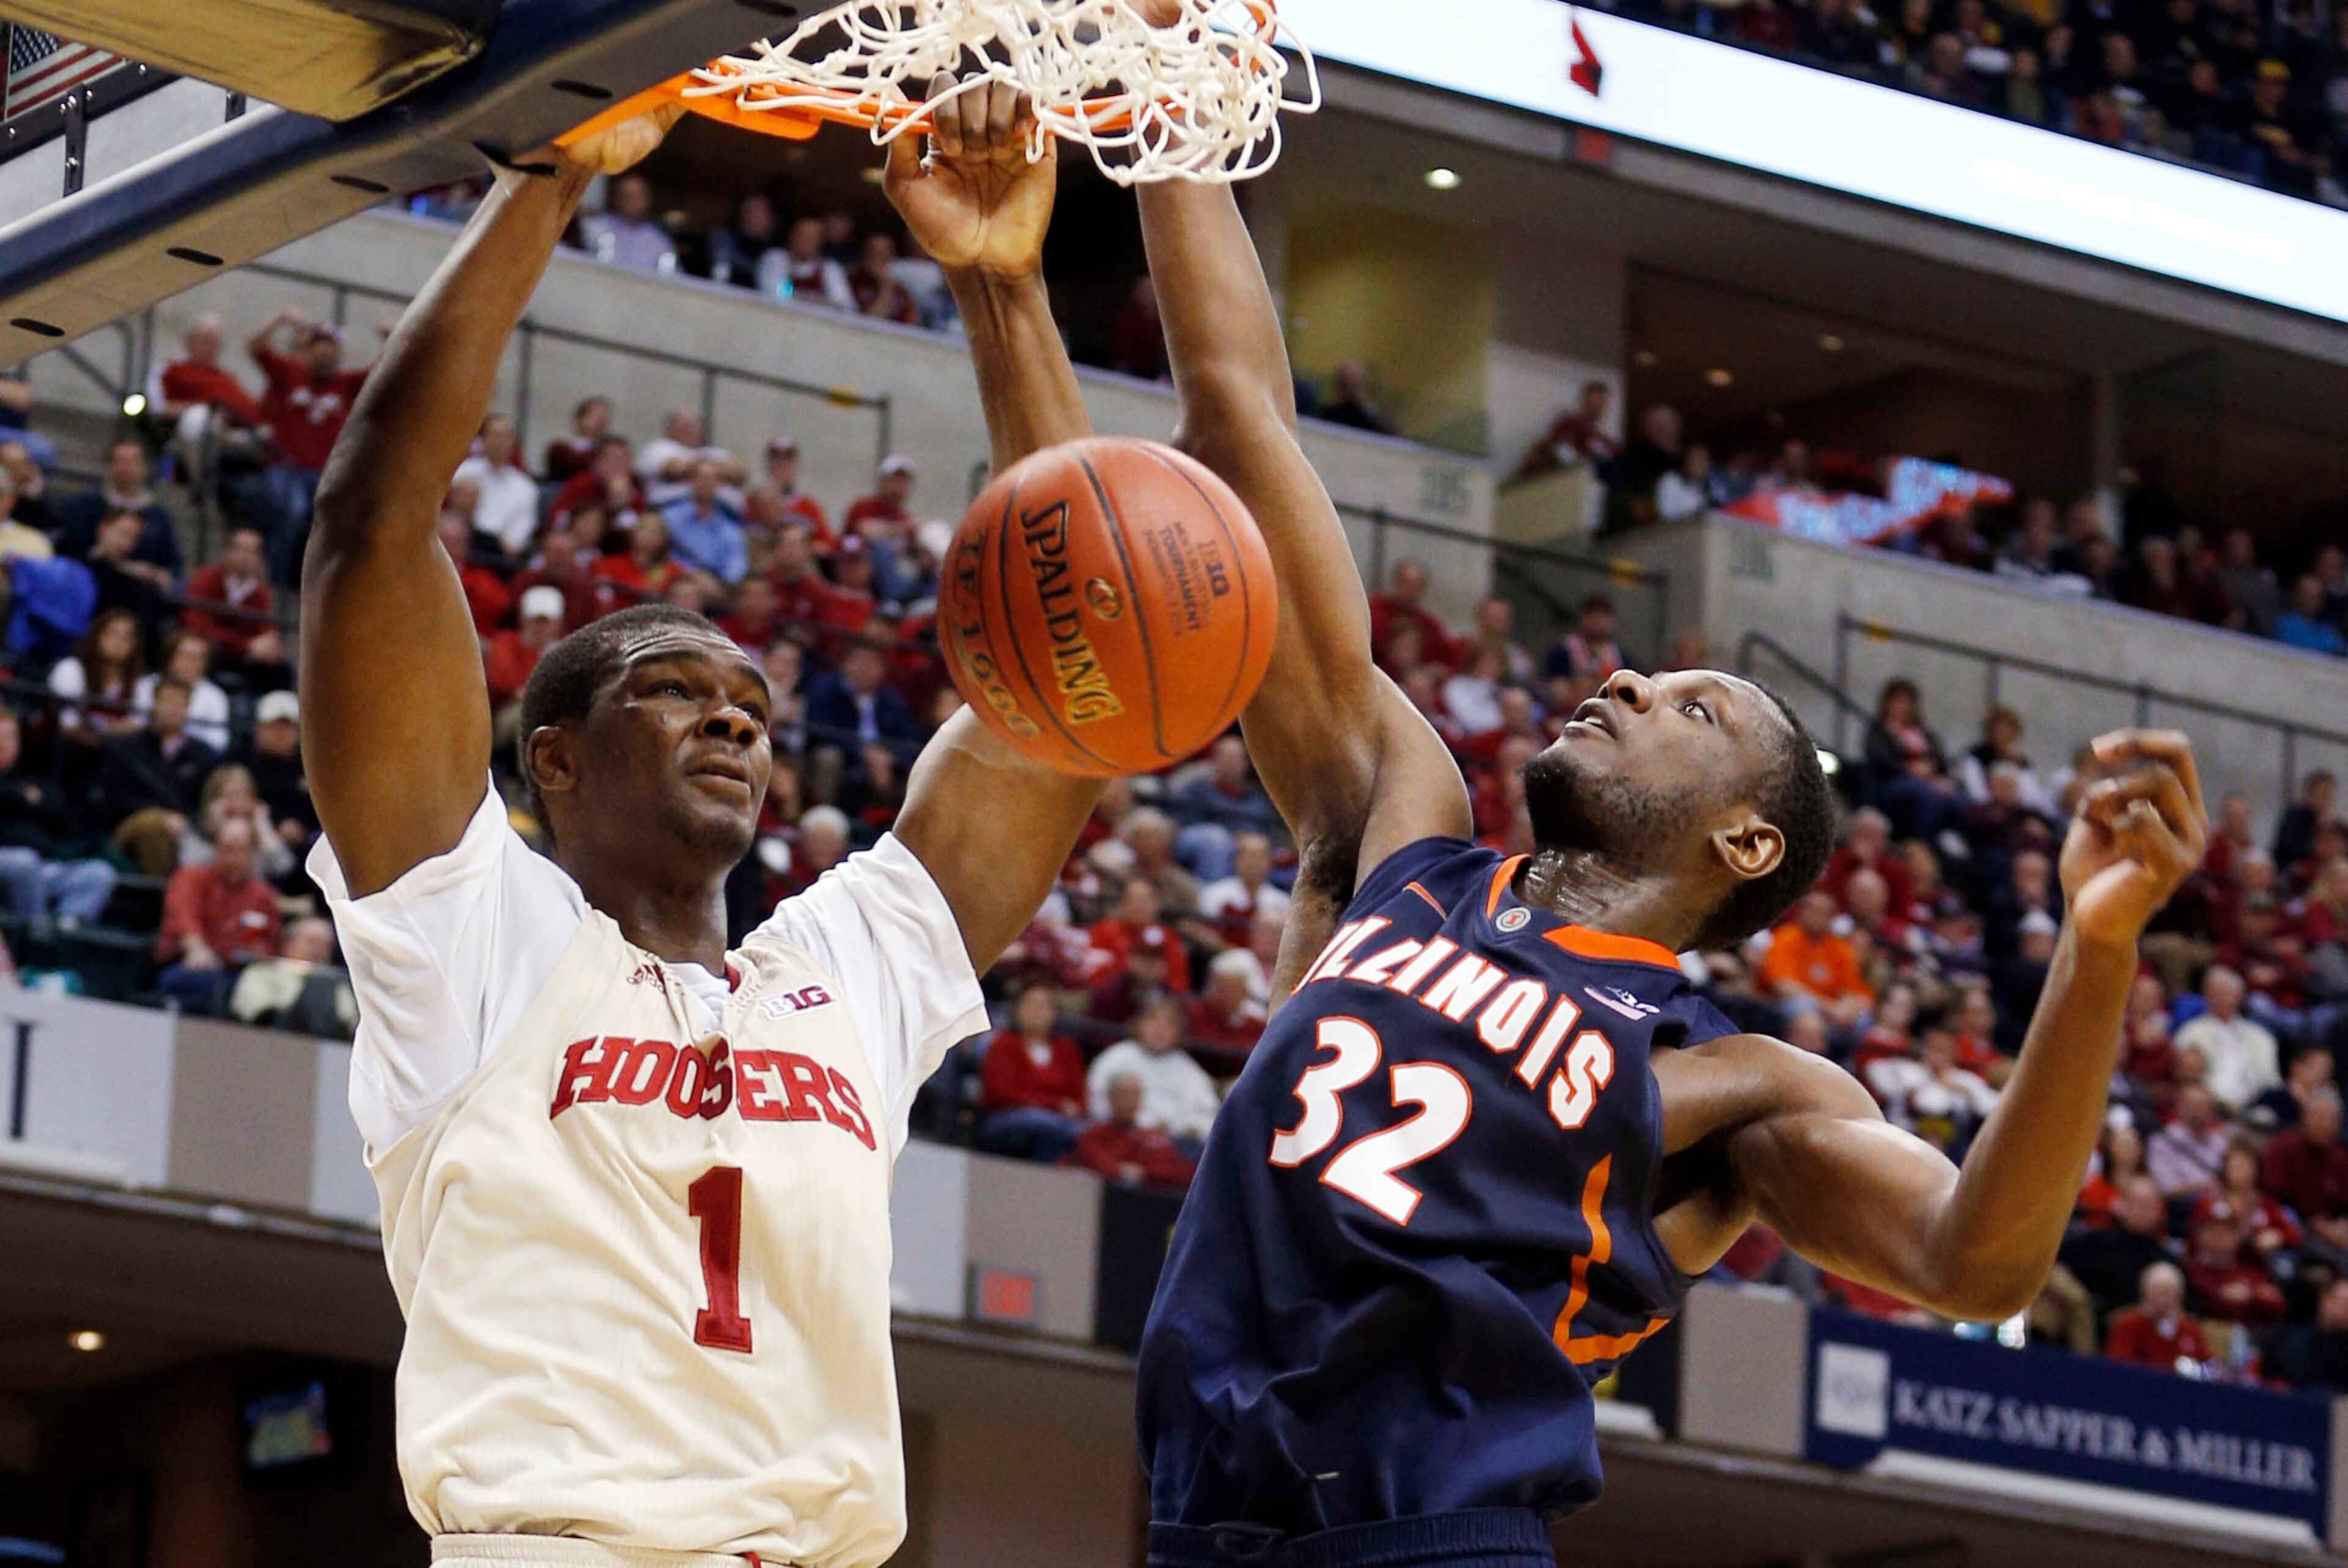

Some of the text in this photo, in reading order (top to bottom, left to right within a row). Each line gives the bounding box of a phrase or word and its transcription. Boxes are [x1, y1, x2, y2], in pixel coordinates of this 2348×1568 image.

[1021, 498, 1124, 724] SPALDING
[1159, 527, 1201, 630] TOURNAMENT
[550, 1036, 877, 1151] HOOSERS
[1290, 915, 1614, 1129] ILLINOIS
[1269, 1015, 1472, 1226] 32
[689, 1165, 753, 1354] 1
[1895, 1378, 2320, 1496] KATZ SAPPER & MILLER
